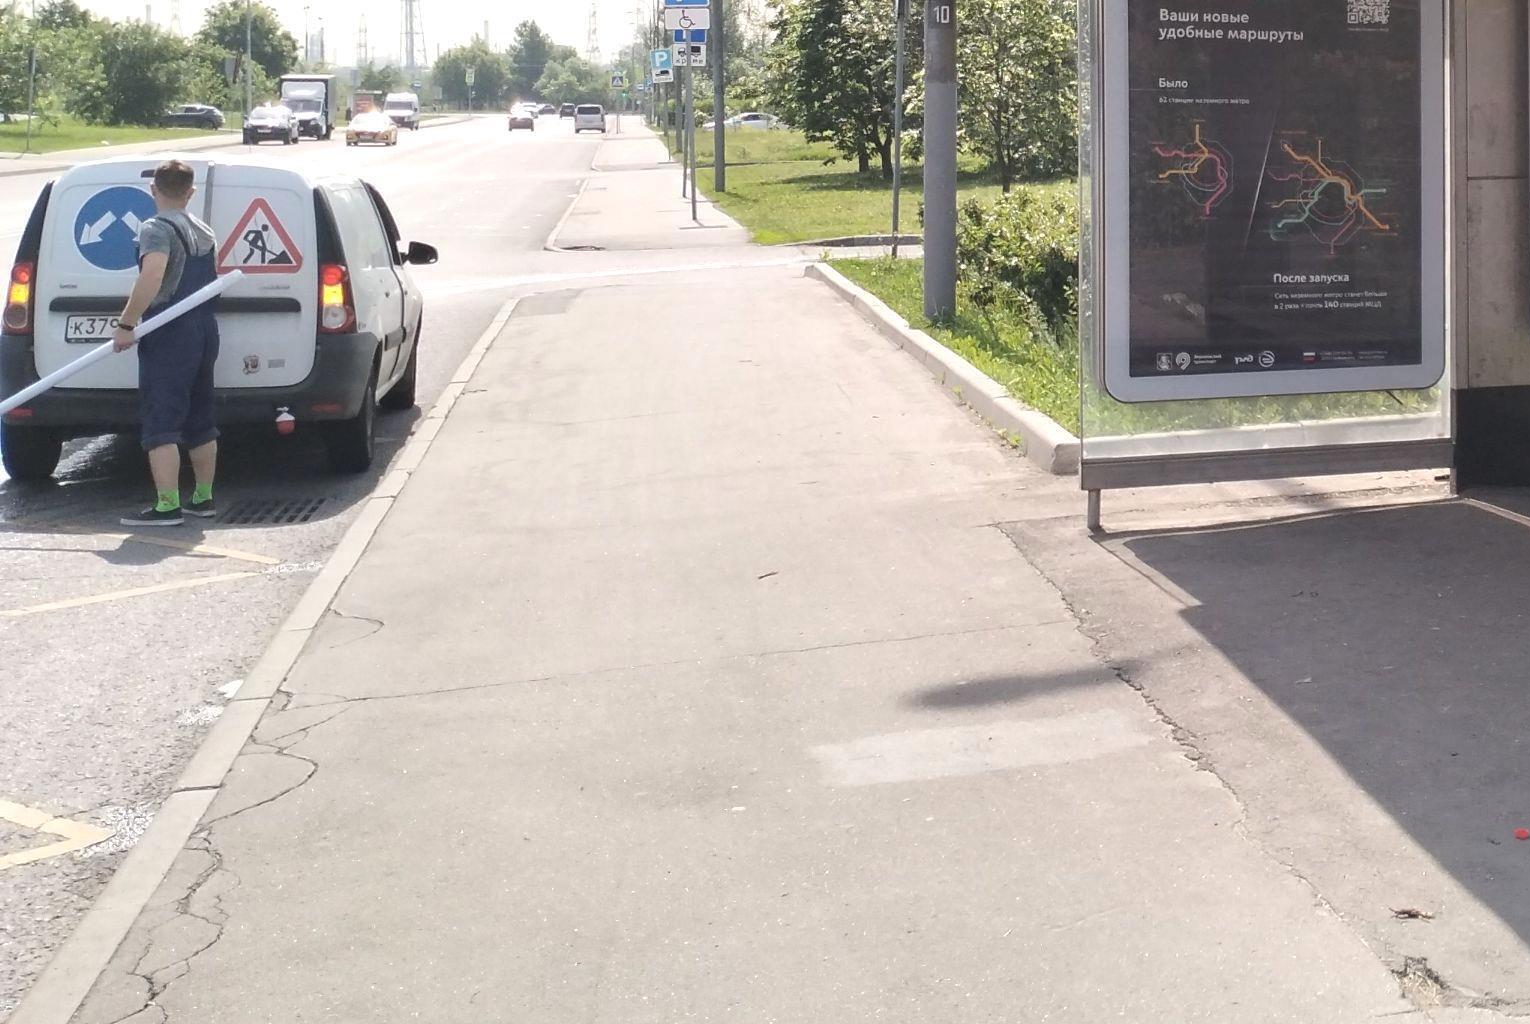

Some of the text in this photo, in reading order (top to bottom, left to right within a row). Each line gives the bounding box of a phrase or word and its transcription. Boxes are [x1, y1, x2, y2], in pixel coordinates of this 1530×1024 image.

[933, 5, 950, 24] 10
[1159, 8, 1250, 24] Ваши новые
[1158, 26, 1304, 44] удобные маршруты
[1158, 77, 1189, 89] Было
[1272, 273, 1350, 285] После запуска
[1324, 300, 1339, 309] 140
